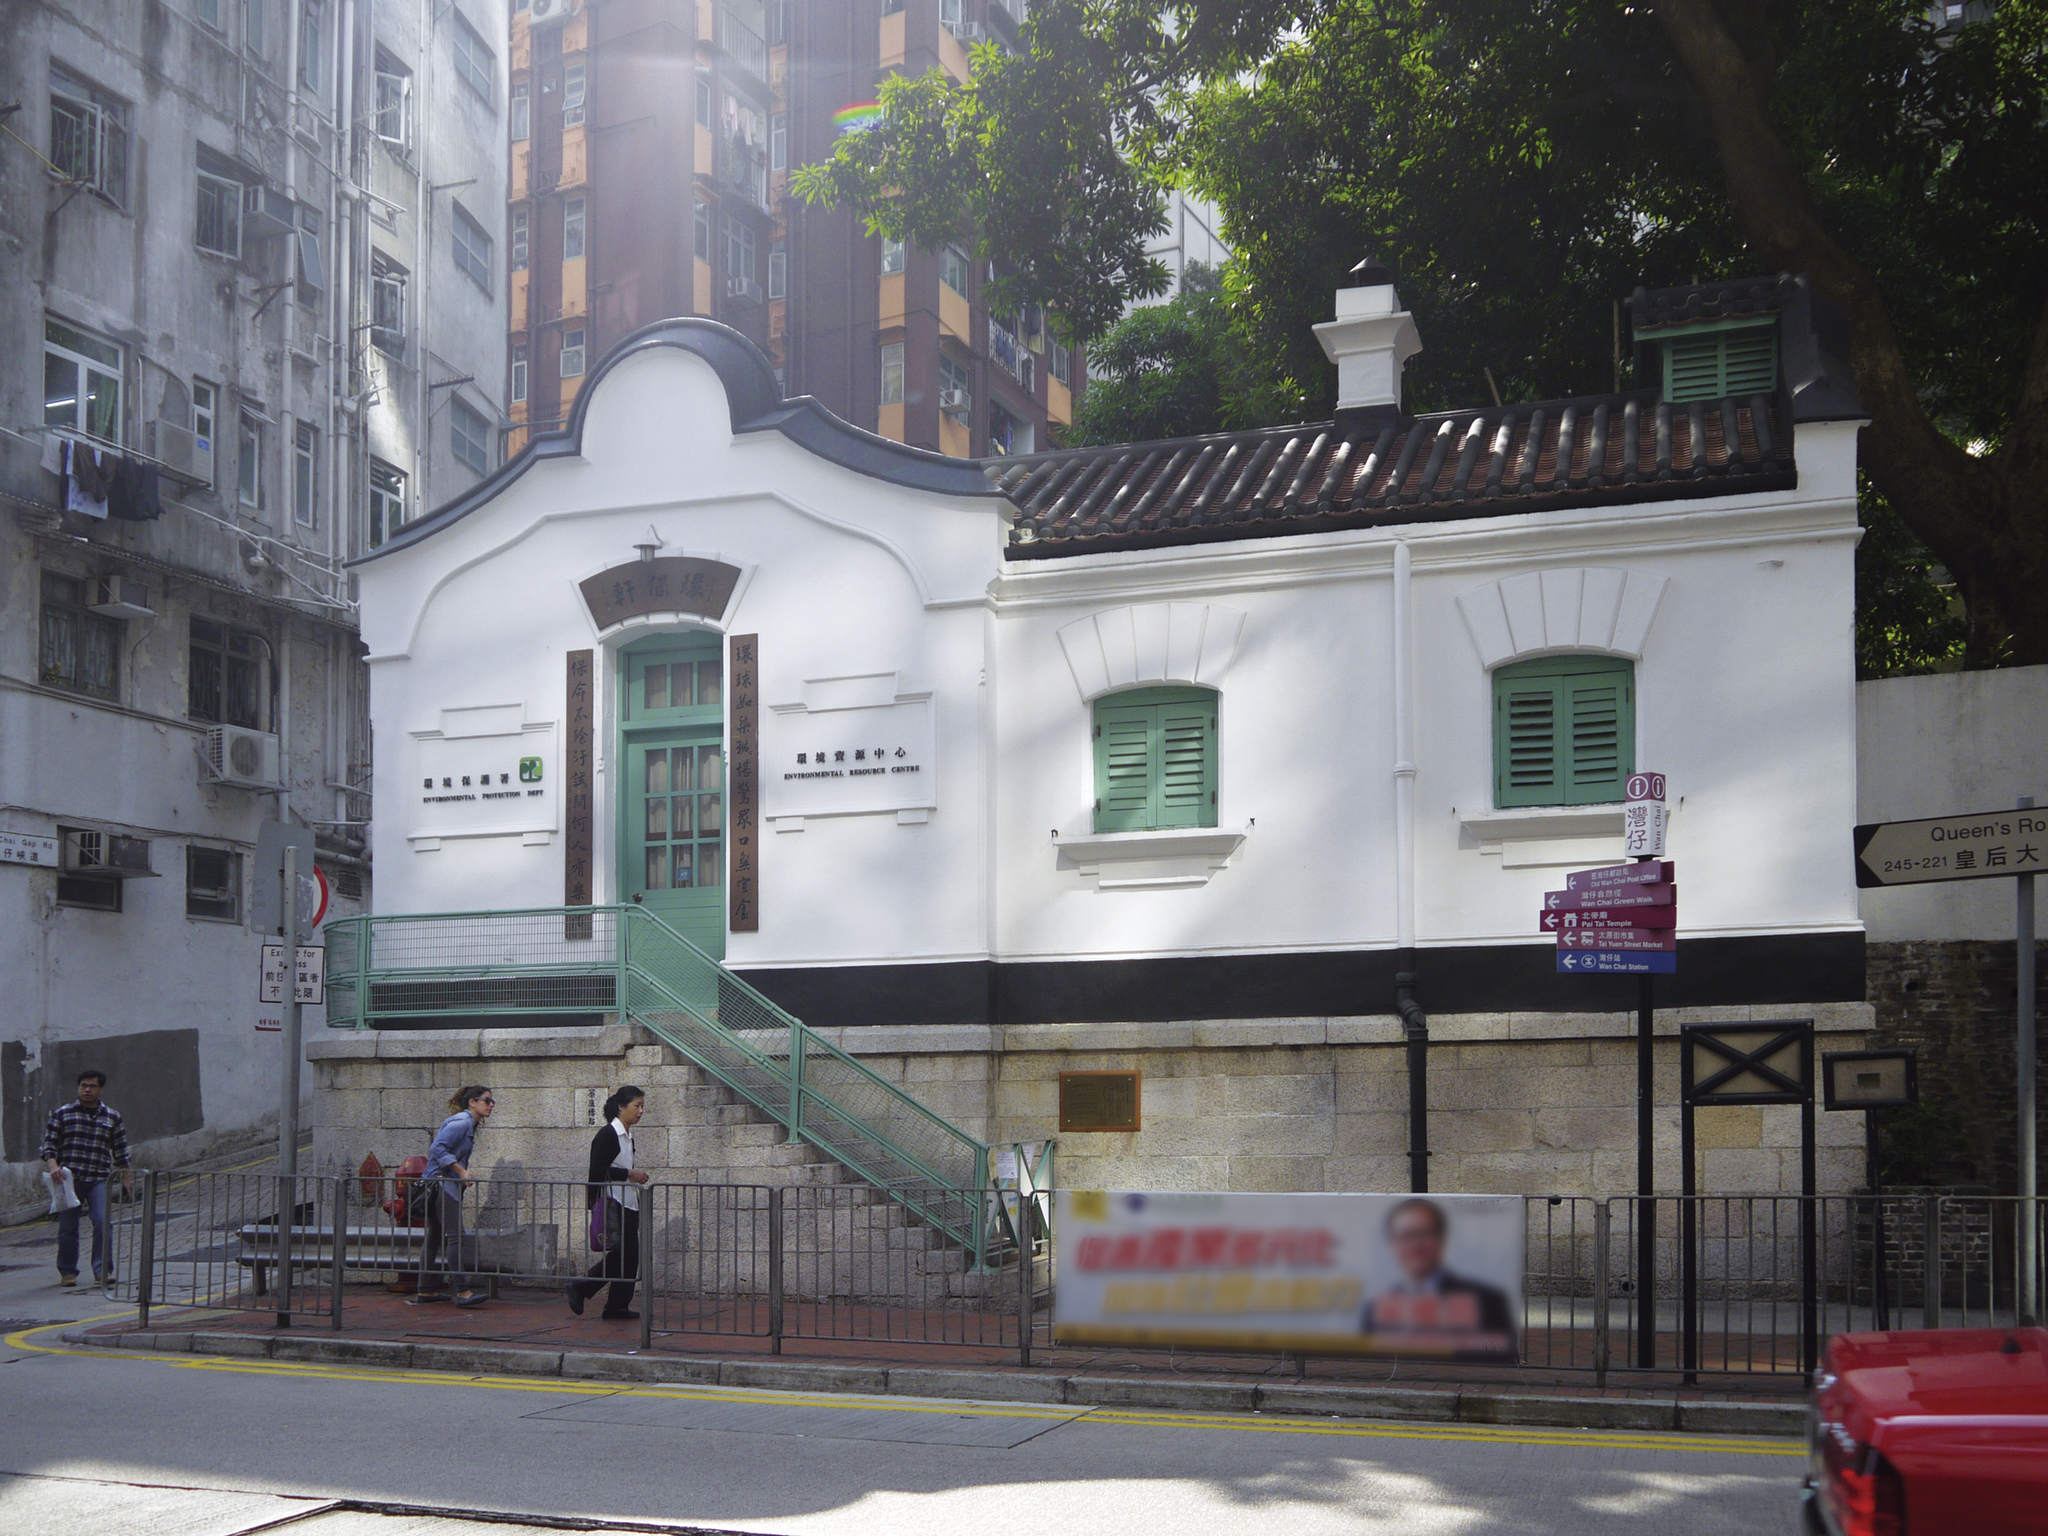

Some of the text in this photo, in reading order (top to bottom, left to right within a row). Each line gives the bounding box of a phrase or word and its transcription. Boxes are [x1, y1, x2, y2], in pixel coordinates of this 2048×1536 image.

[796, 746, 907, 765] 環境資源中心
[783, 764, 921, 781] ENVIRONMENTAL RESOURCE CENTRE
[422, 789, 545, 804] ENVIRONMENTAL PROTECTION DEPT
[1627, 805, 1649, 851] 灣仔
[1654, 804, 1662, 851] Wan Chai
[1930, 821, 2012, 842] Queen's
[1883, 855, 1949, 873] 245-221
[1954, 843, 2040, 871] 皇后大
[1581, 900, 1596, 908] Wan
[1606, 919, 1633, 928] Temple
[1624, 940, 1642, 948] Street
[303, 948, 316, 958] for
[1598, 962, 1612, 970] Wan
[1628, 963, 1649, 971] Station
